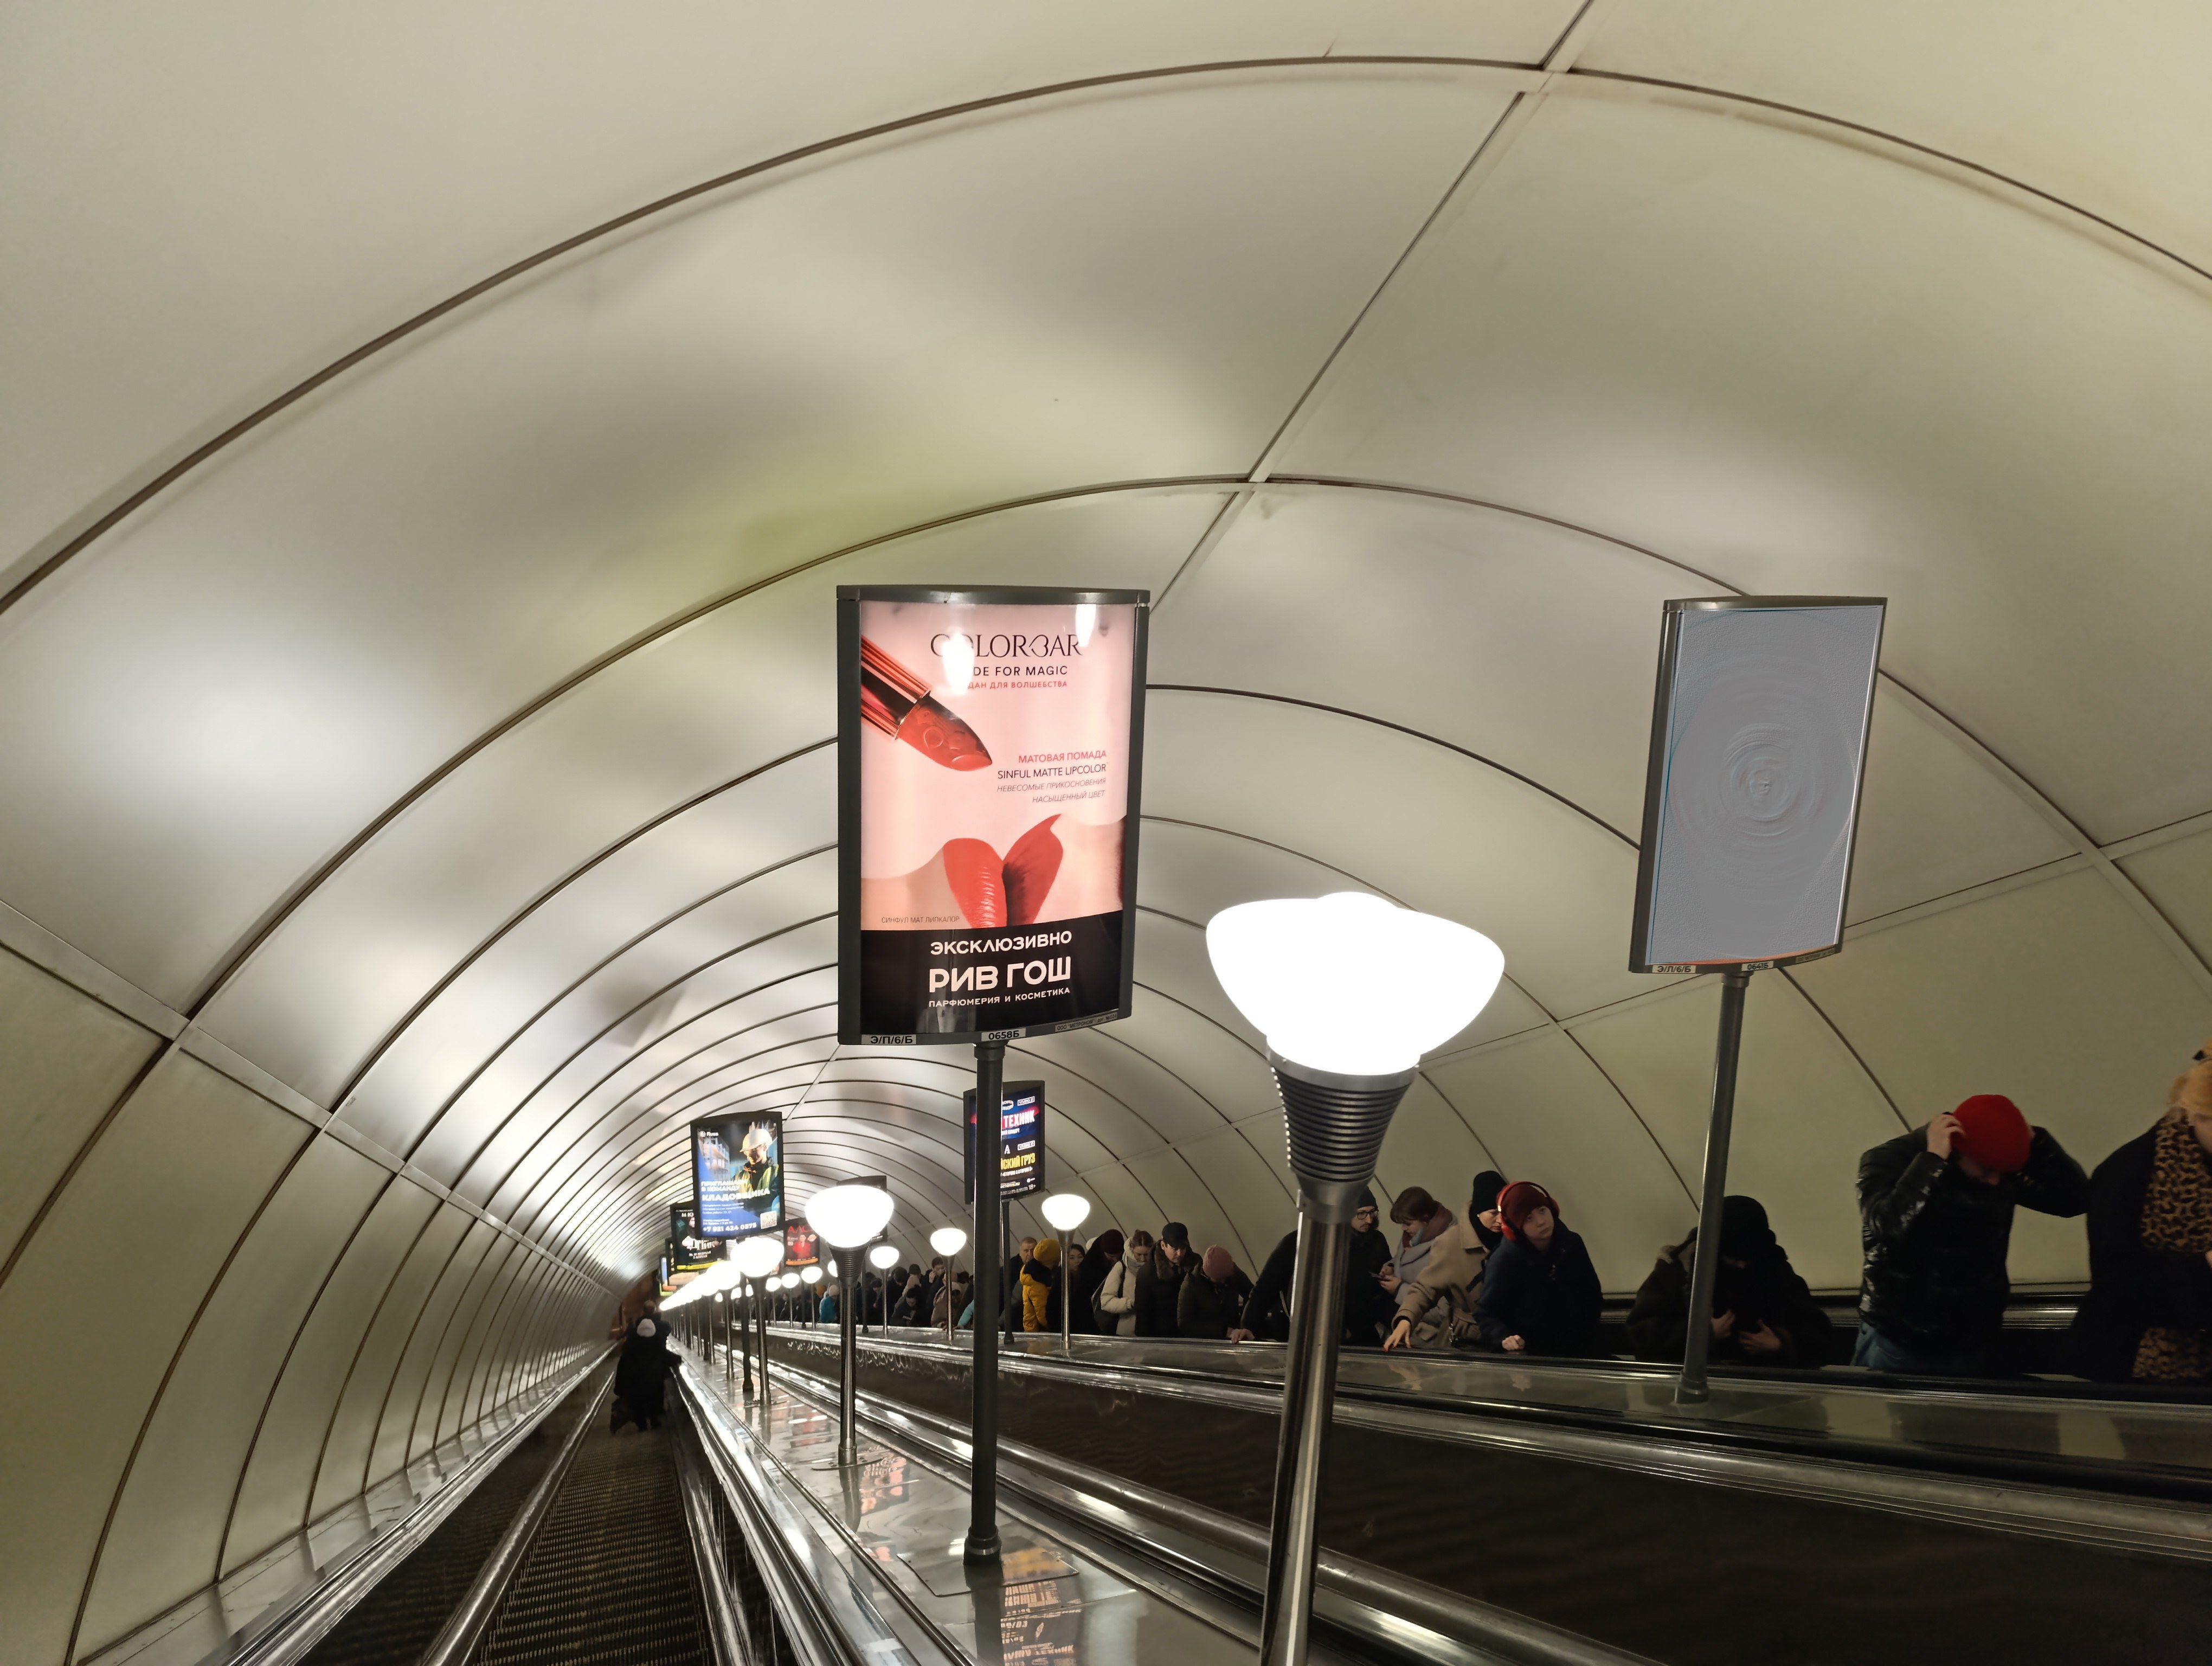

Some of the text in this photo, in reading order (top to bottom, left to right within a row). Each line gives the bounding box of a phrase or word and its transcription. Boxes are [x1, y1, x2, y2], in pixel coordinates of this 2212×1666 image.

[995, 667, 1020, 676] FOR
[1026, 665, 1068, 676] MAGIC
[989, 681, 1008, 689] ДЛЯ
[1018, 750, 1107, 764] МАТОВАЯ ПОМАДА
[998, 764, 1107, 779] SINFUL MATTE LIPCOLOR
[997, 777, 1107, 792] НЕВЕСОМЫЕ ПРИКОСНОВЕНИЯ
[1032, 790, 1106, 803] НАСЫЩЕННЫЙ ЦВЕТ
[930, 930, 1072, 956] ЭКСКЛЮЗИВНО
[929, 956, 1071, 994] РИВ ГОШ
[929, 995, 1000, 1008] ПАРФЮМЕРИЯ
[1015, 987, 1071, 1002] КОСМЕТИКА
[870, 1030, 1020, 1045] Э/П/6/Б 0658Б
[1003, 1110, 1035, 1128] ТЕХНИК
[1021, 1152, 1036, 1166] ГРУЗ
[702, 1188, 770, 1202] КЛАДОВЩИКА
